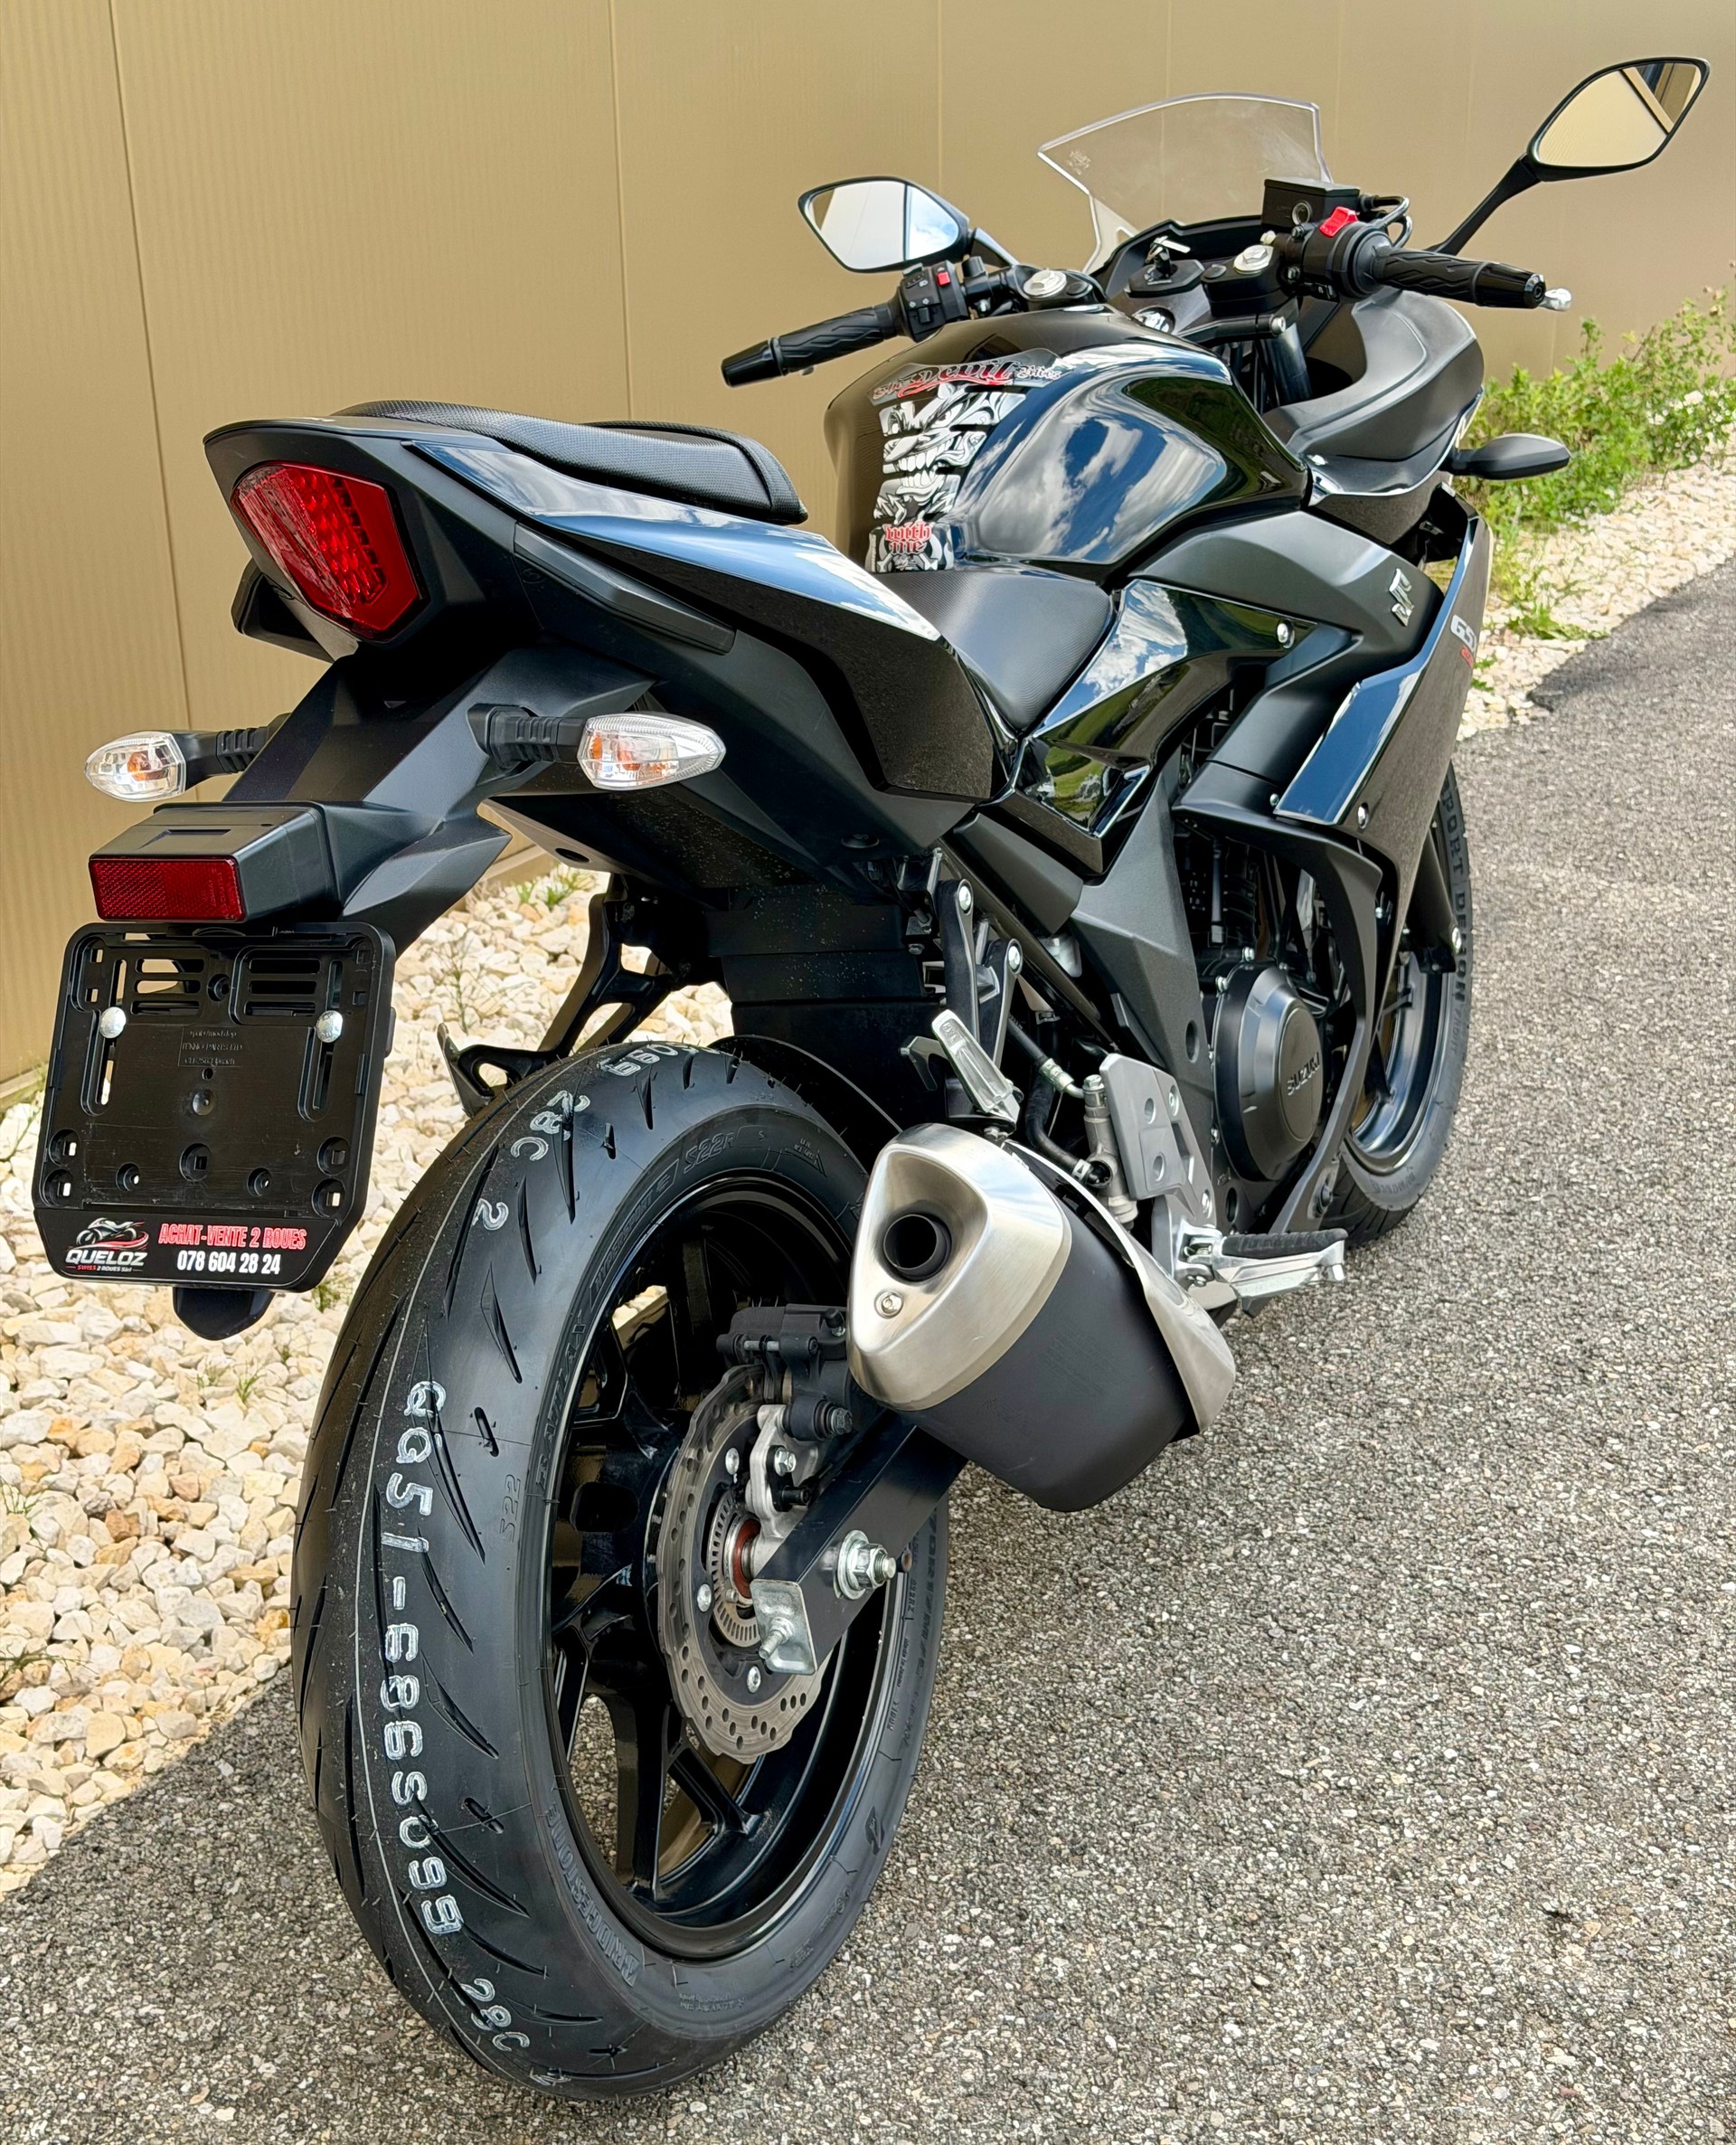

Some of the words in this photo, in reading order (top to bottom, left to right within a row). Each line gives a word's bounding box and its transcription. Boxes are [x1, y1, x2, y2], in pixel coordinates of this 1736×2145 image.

[896, 359, 1022, 398] Devil
[884, 522, 932, 542] with
[1287, 1052, 1320, 1097] SUZUKI
[158, 1223, 248, 1248] ACHAT-VENTE
[249, 1226, 261, 1248] 2
[262, 1227, 307, 1250] ROUES
[65, 1249, 148, 1266] QUELOZ
[176, 1250, 206, 1271] 078
[208, 1251, 237, 1273] 604
[239, 1252, 259, 1274] 28
[260, 1253, 282, 1275] 24
[546, 1805, 642, 1988] BRIDGESTONE
